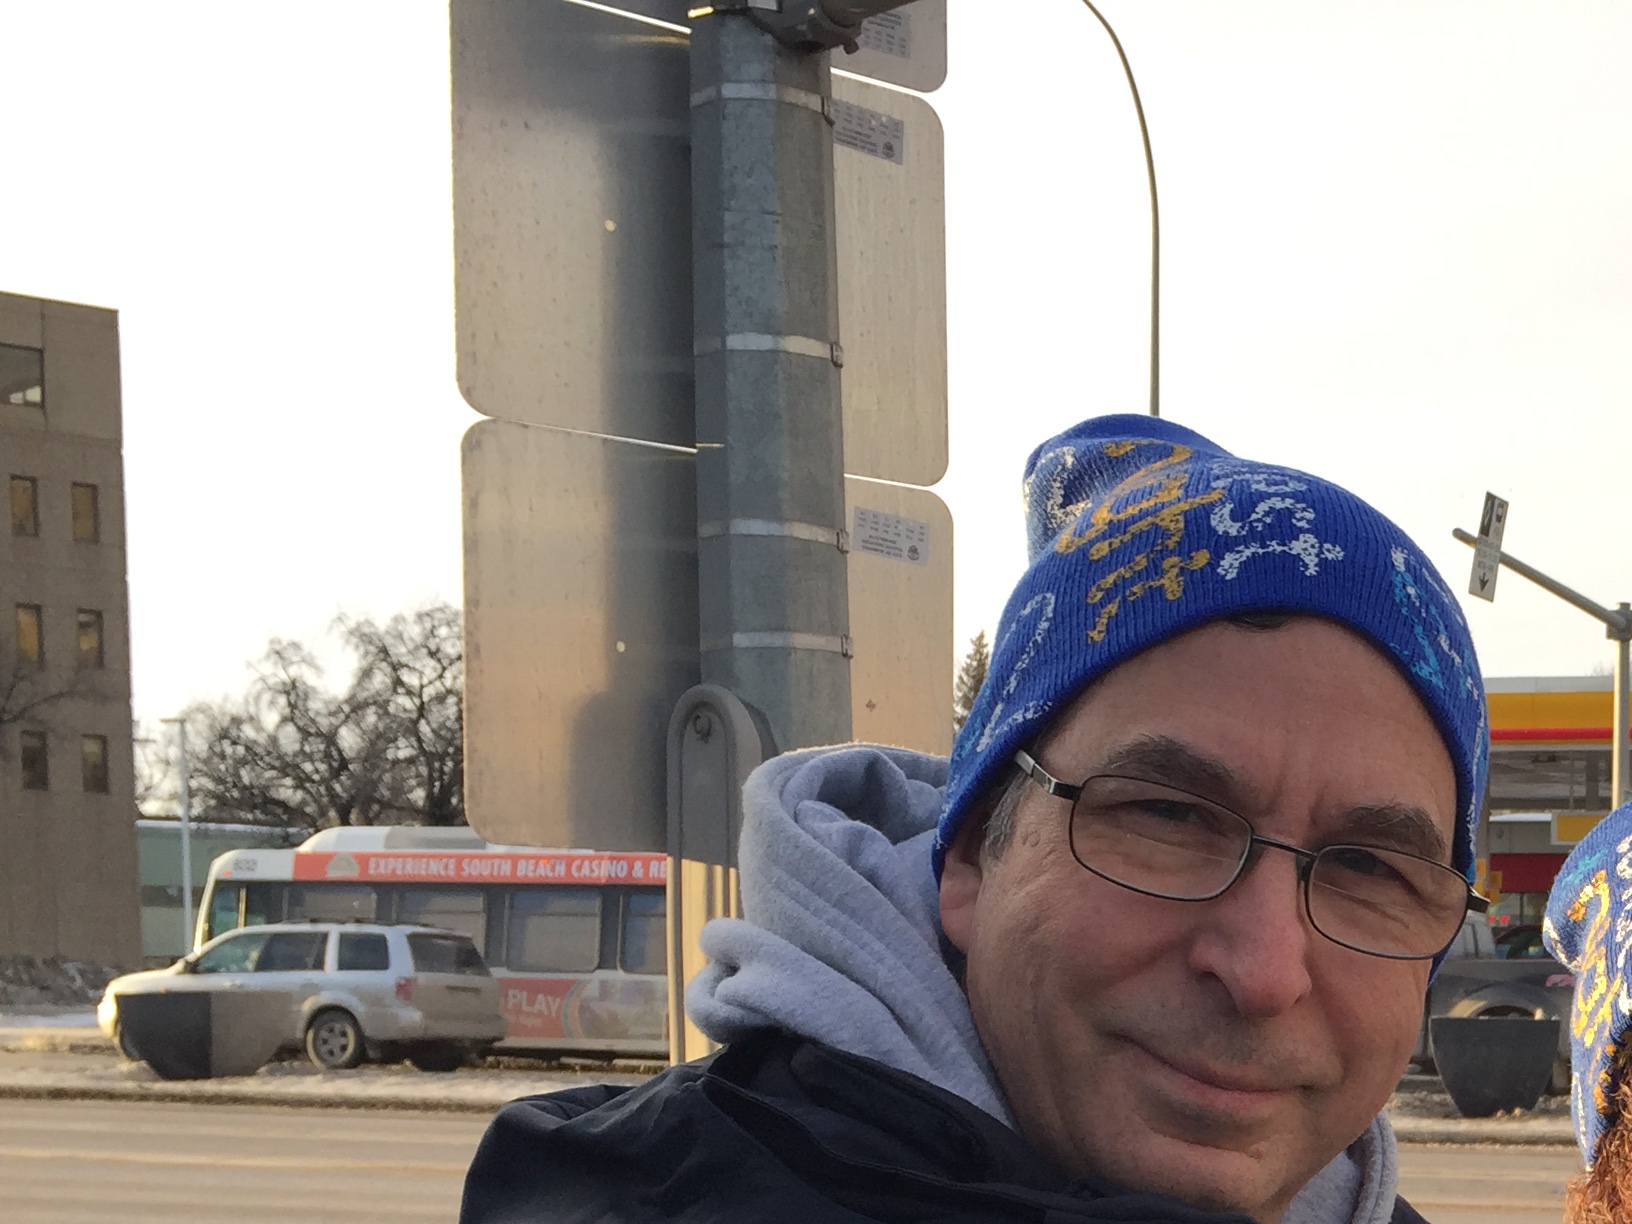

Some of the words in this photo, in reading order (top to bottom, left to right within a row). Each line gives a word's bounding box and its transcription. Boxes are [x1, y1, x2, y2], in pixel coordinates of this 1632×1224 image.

[368, 856, 456, 876] EXPERIENCE
[461, 857, 512, 877] SOUTH
[516, 857, 566, 878] BEACH
[571, 858, 627, 879] CASINO
[631, 860, 643, 879] &
[507, 988, 561, 1018] PLAY
